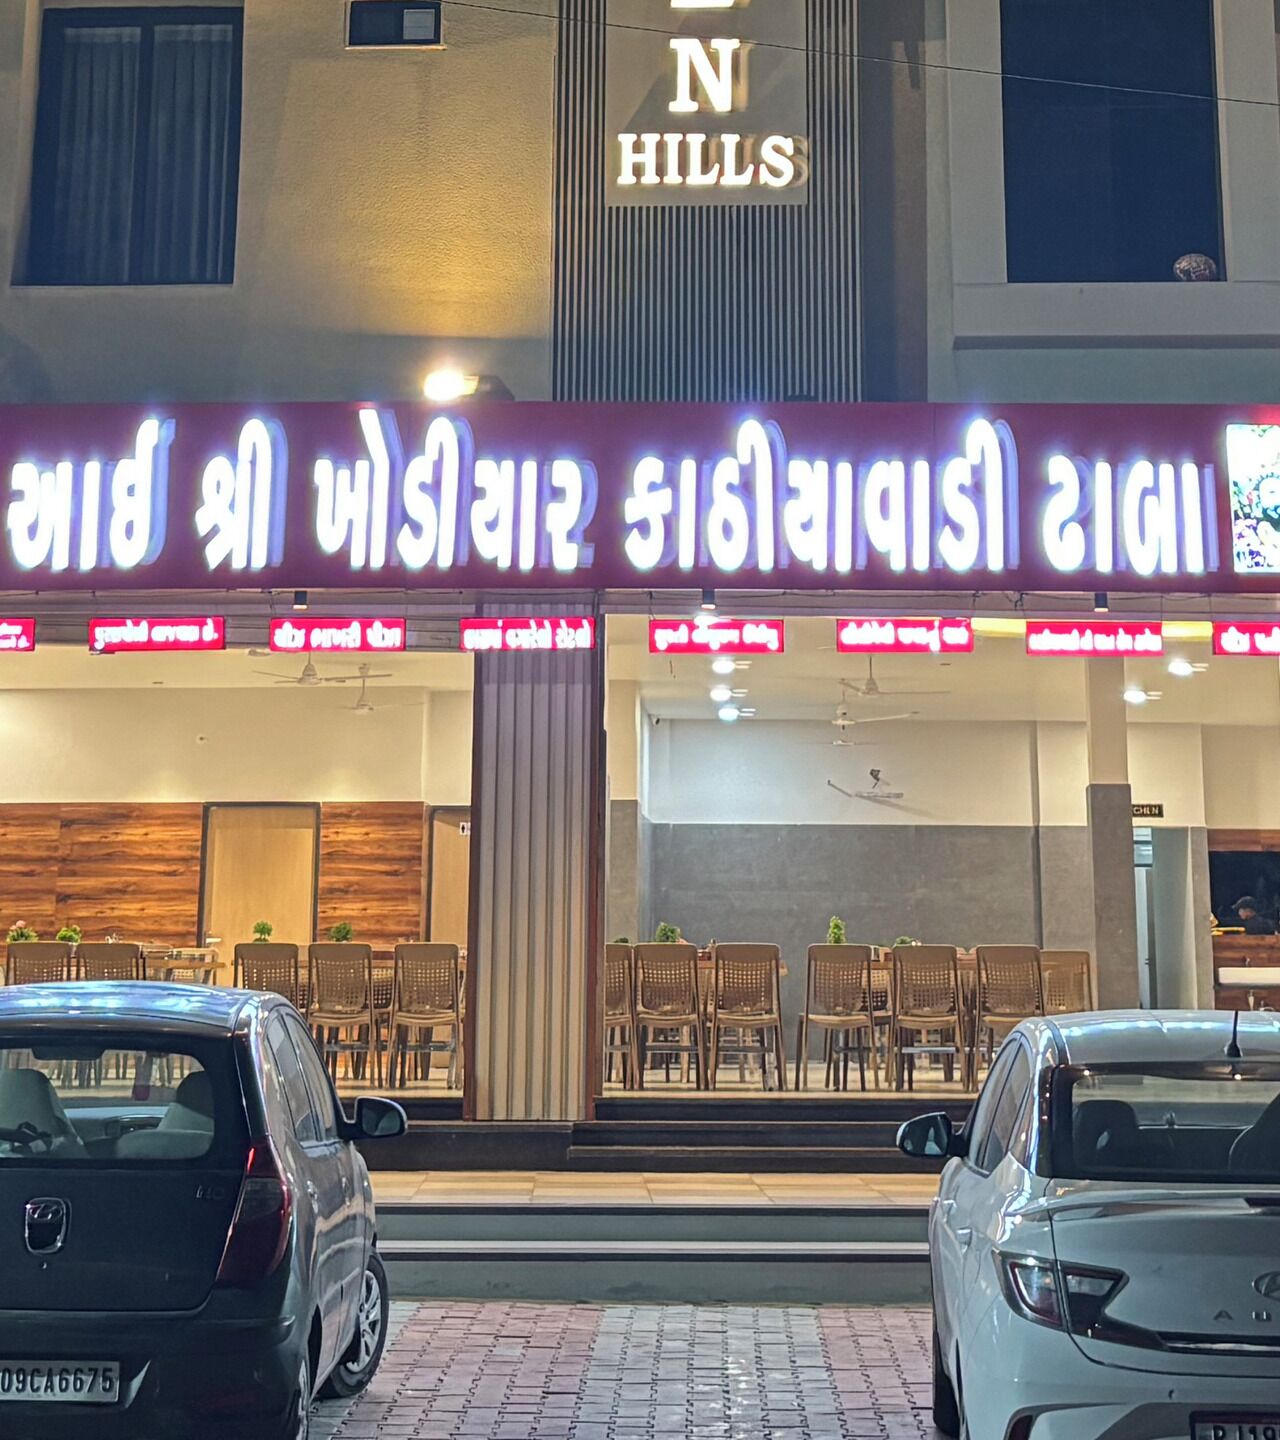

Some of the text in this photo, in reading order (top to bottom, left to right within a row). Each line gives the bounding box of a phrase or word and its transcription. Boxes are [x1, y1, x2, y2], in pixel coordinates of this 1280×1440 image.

[617, 133, 795, 187] HILLS
[7, 408, 1206, 575] આઈ શ્રી ખોડીયાર કાઠીયાવાડી ઢાબા
